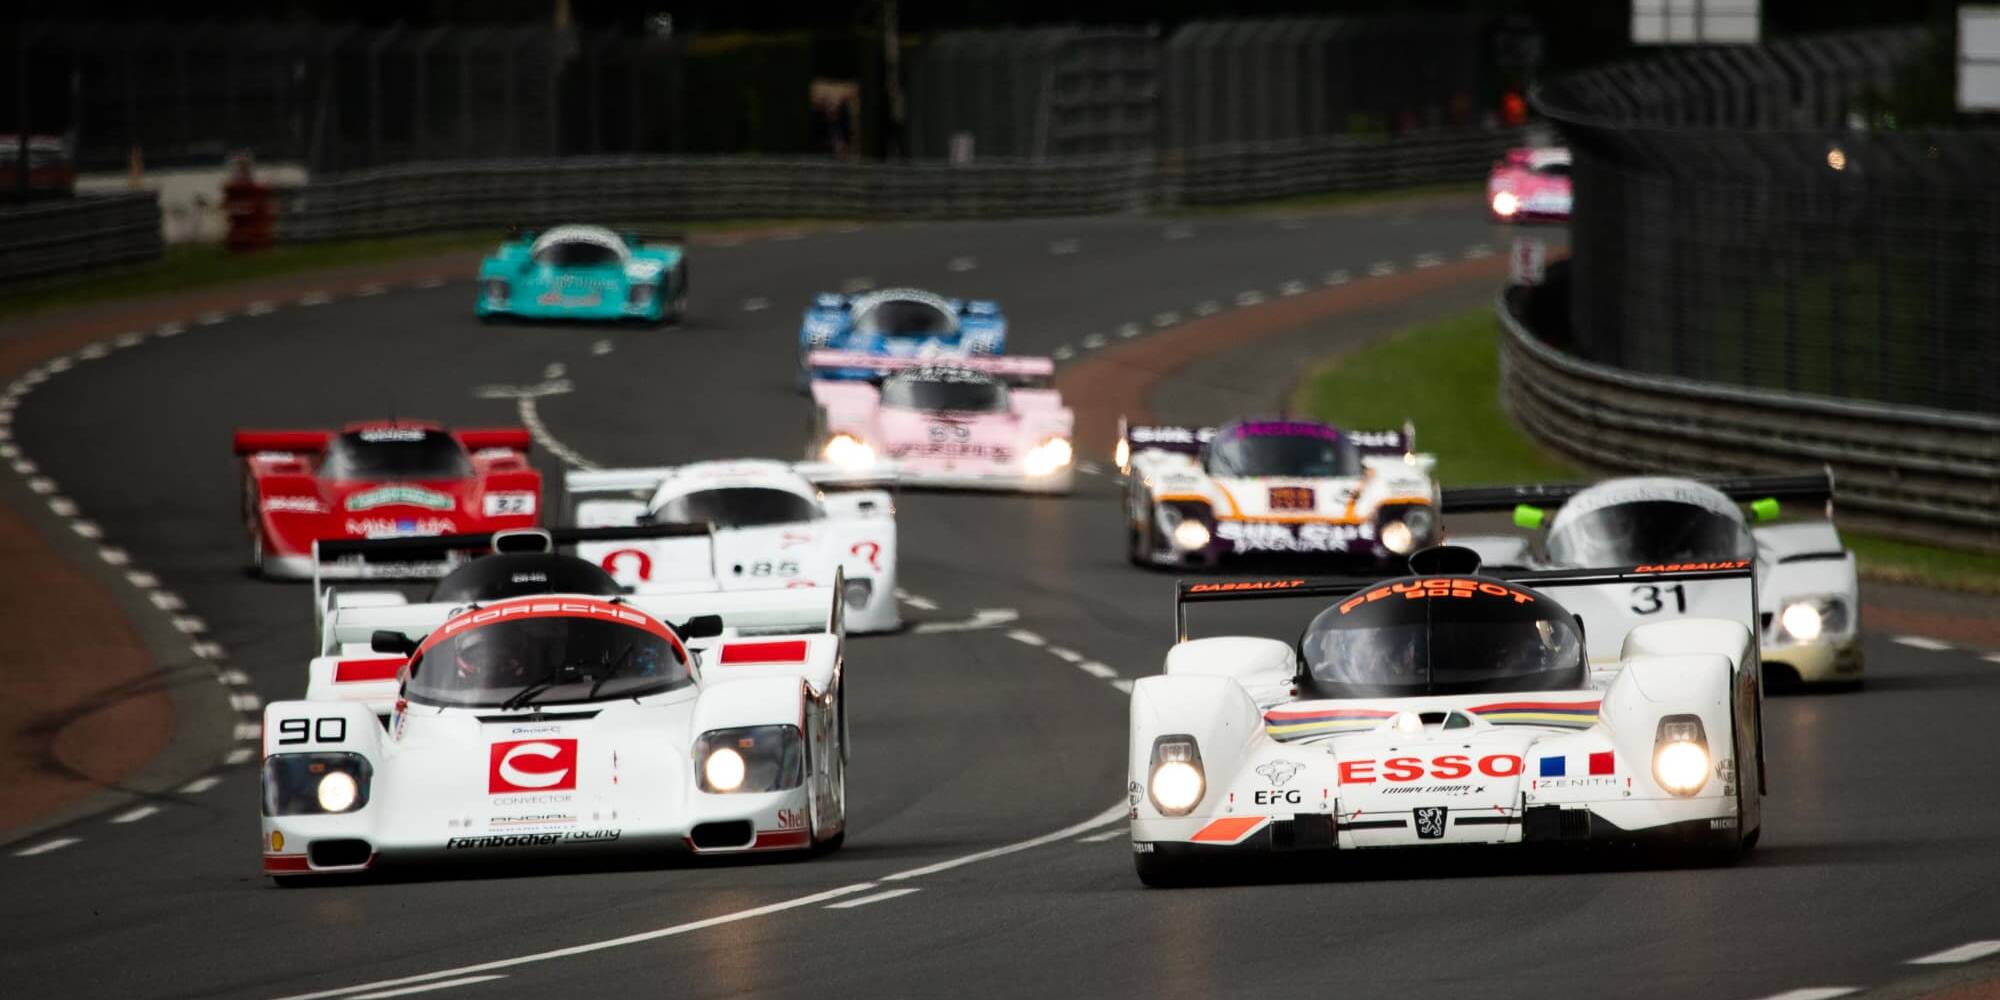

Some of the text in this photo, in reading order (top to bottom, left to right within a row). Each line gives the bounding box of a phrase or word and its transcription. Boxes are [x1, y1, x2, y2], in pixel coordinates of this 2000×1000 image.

[1634, 560, 1751, 573] DASSAULT
[1189, 580, 1306, 592] DASSAULT
[1338, 578, 1535, 616] PEUGEOT
[1631, 583, 1687, 615] 31
[444, 603, 647, 634] PORSCHE
[278, 717, 347, 746] 90
[1338, 753, 1526, 785] ESSO
[1539, 777, 1617, 789] ZENITH
[493, 795, 573, 807] CONVECTOR
[1254, 789, 1302, 806] EFG
[564, 828, 622, 843] racing
